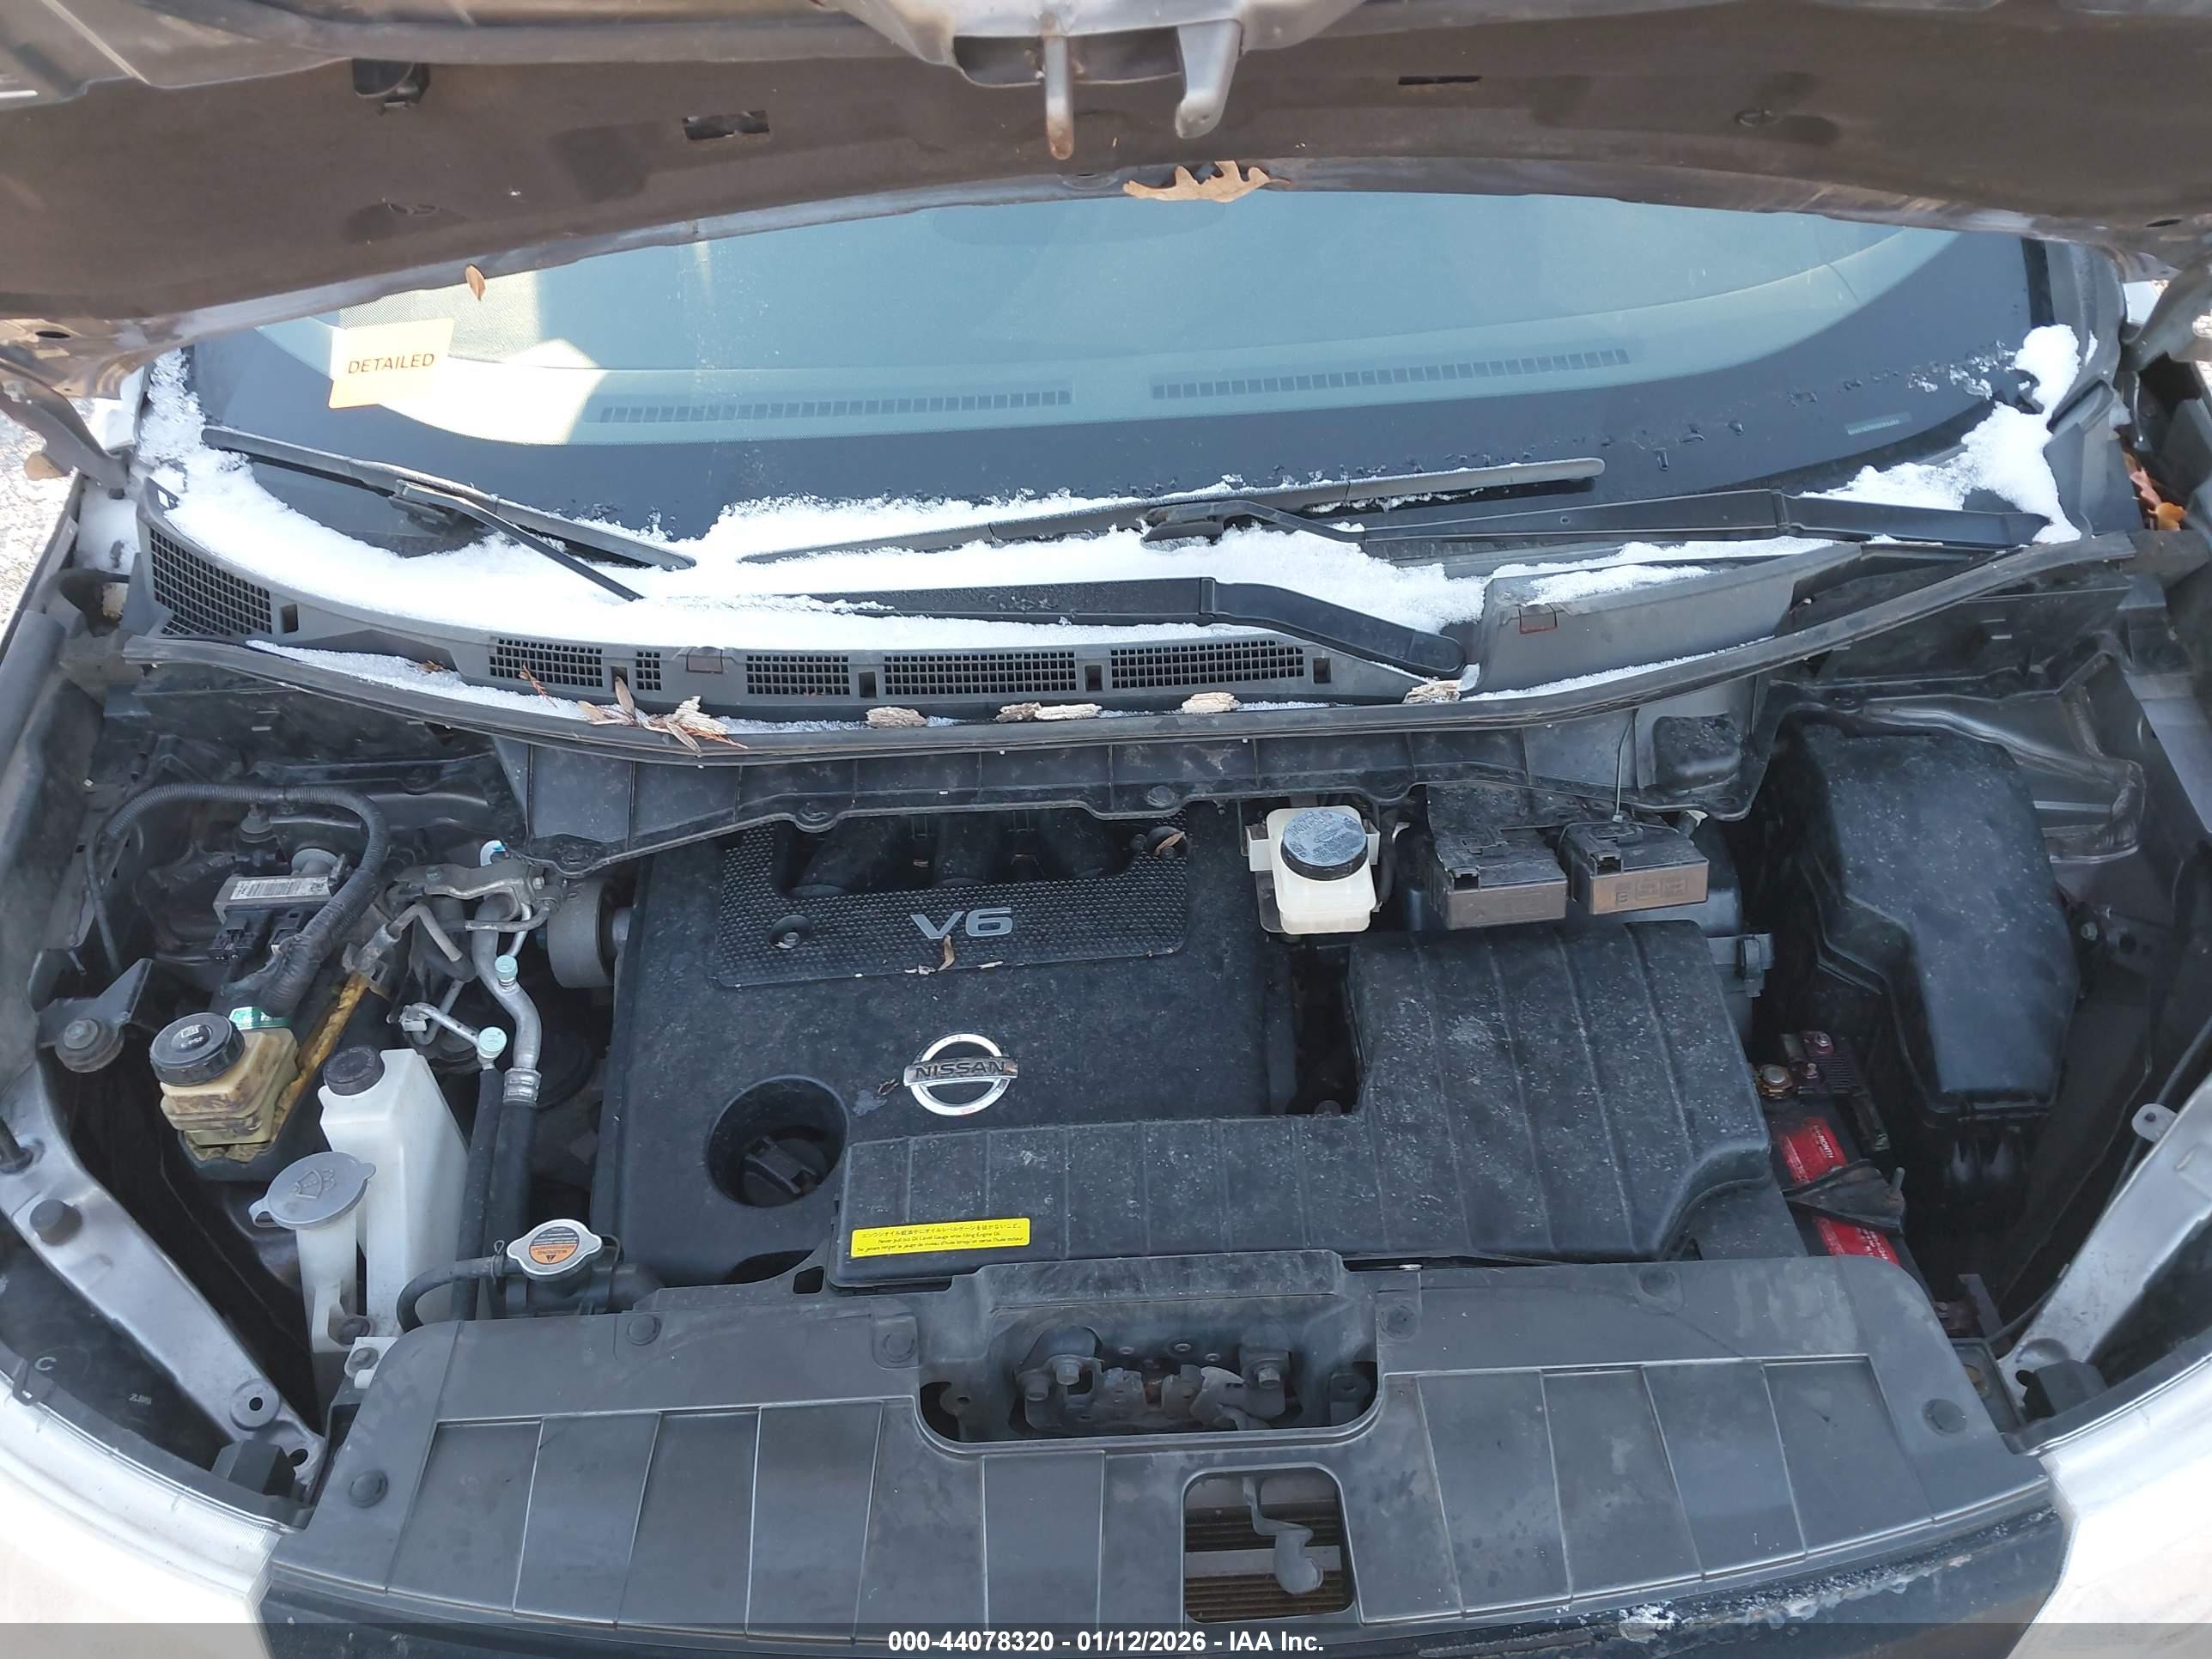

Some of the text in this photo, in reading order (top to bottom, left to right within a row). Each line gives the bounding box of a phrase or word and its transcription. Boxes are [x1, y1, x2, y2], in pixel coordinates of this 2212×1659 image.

[347, 352, 435, 374] DETAILED
[909, 906, 1014, 940] V6
[915, 1059, 1006, 1080] NISSAN
